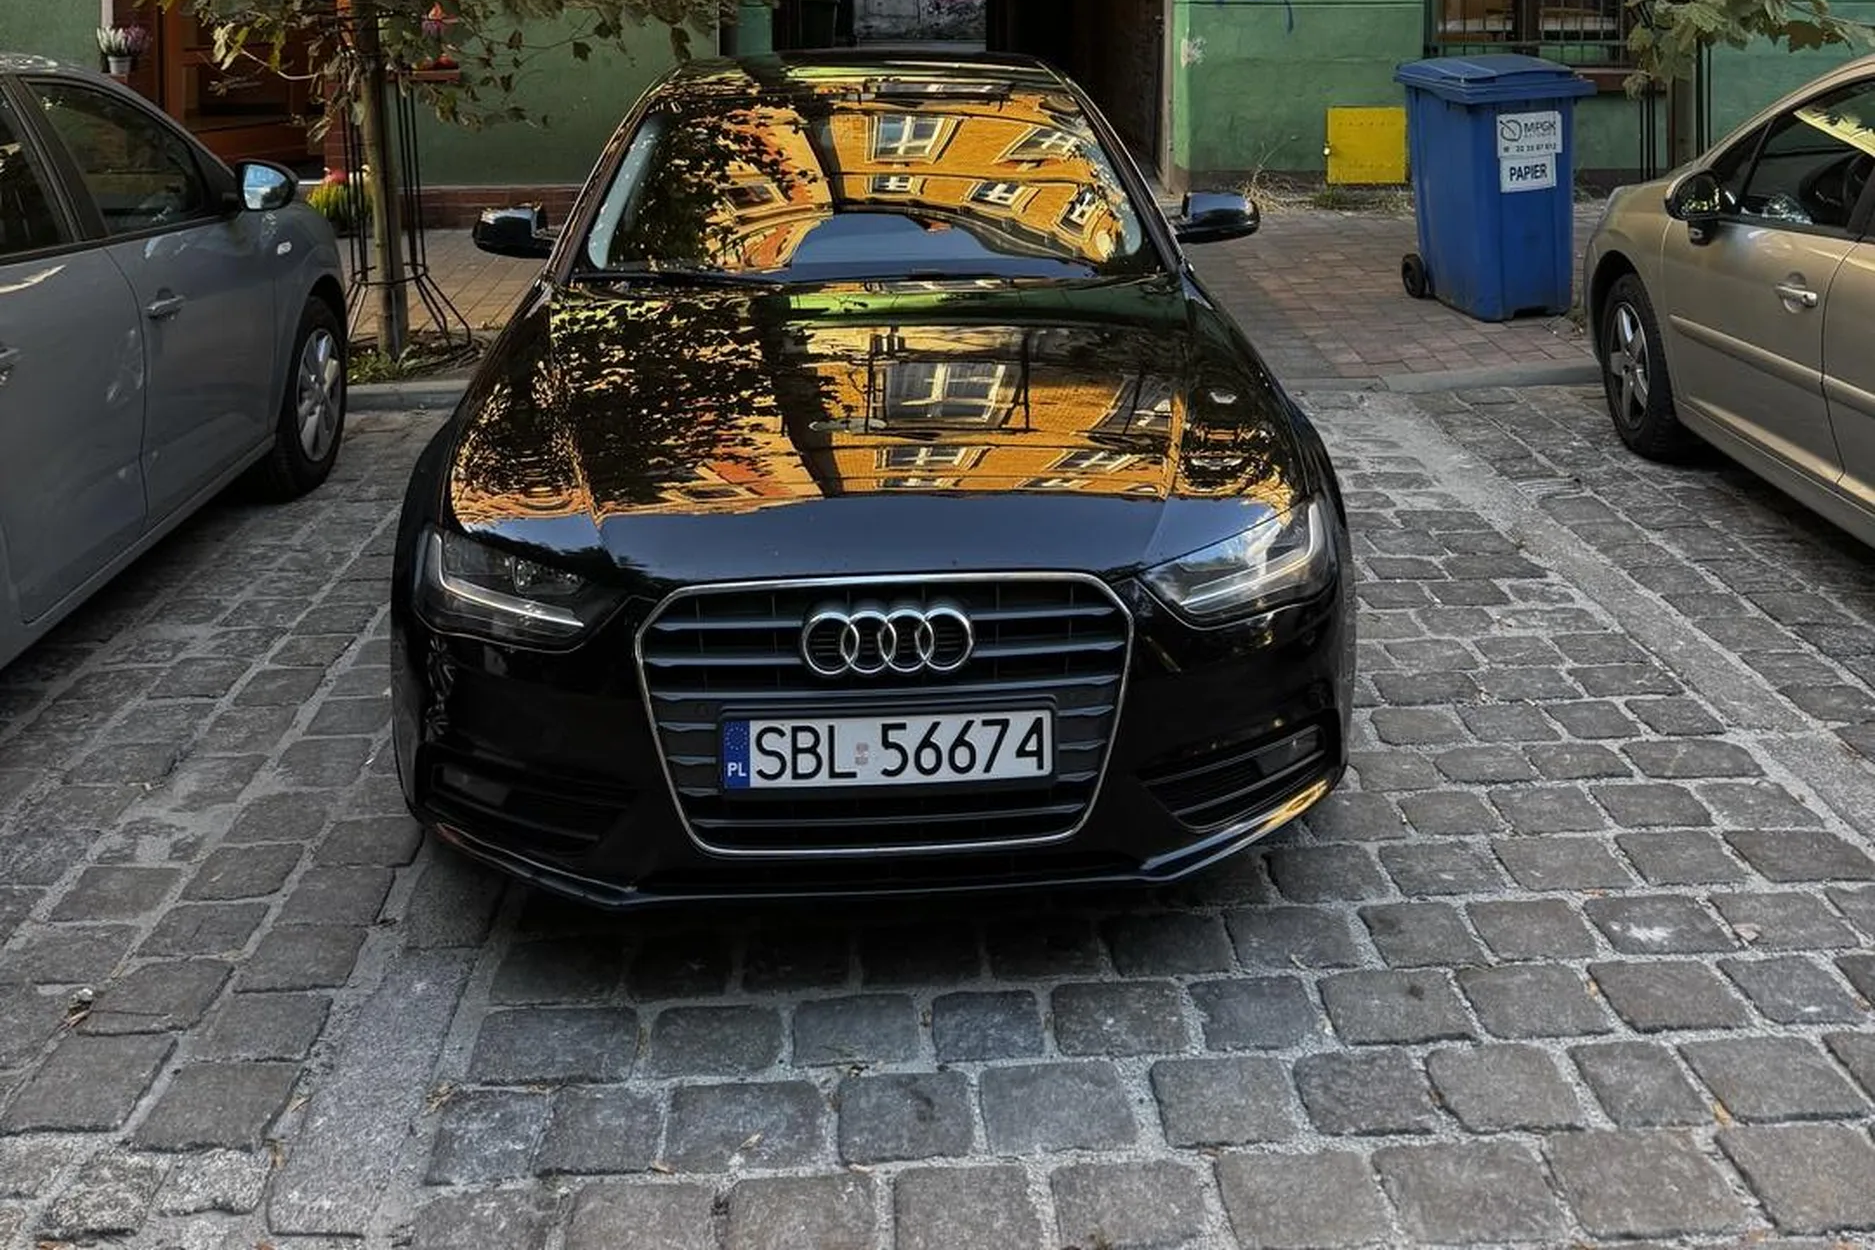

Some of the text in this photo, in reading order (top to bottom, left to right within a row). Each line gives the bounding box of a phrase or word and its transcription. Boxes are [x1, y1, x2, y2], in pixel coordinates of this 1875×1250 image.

[1509, 163, 1548, 181] PAPIER
[755, 716, 1045, 781] SBL 56674
[727, 761, 747, 777] PL
